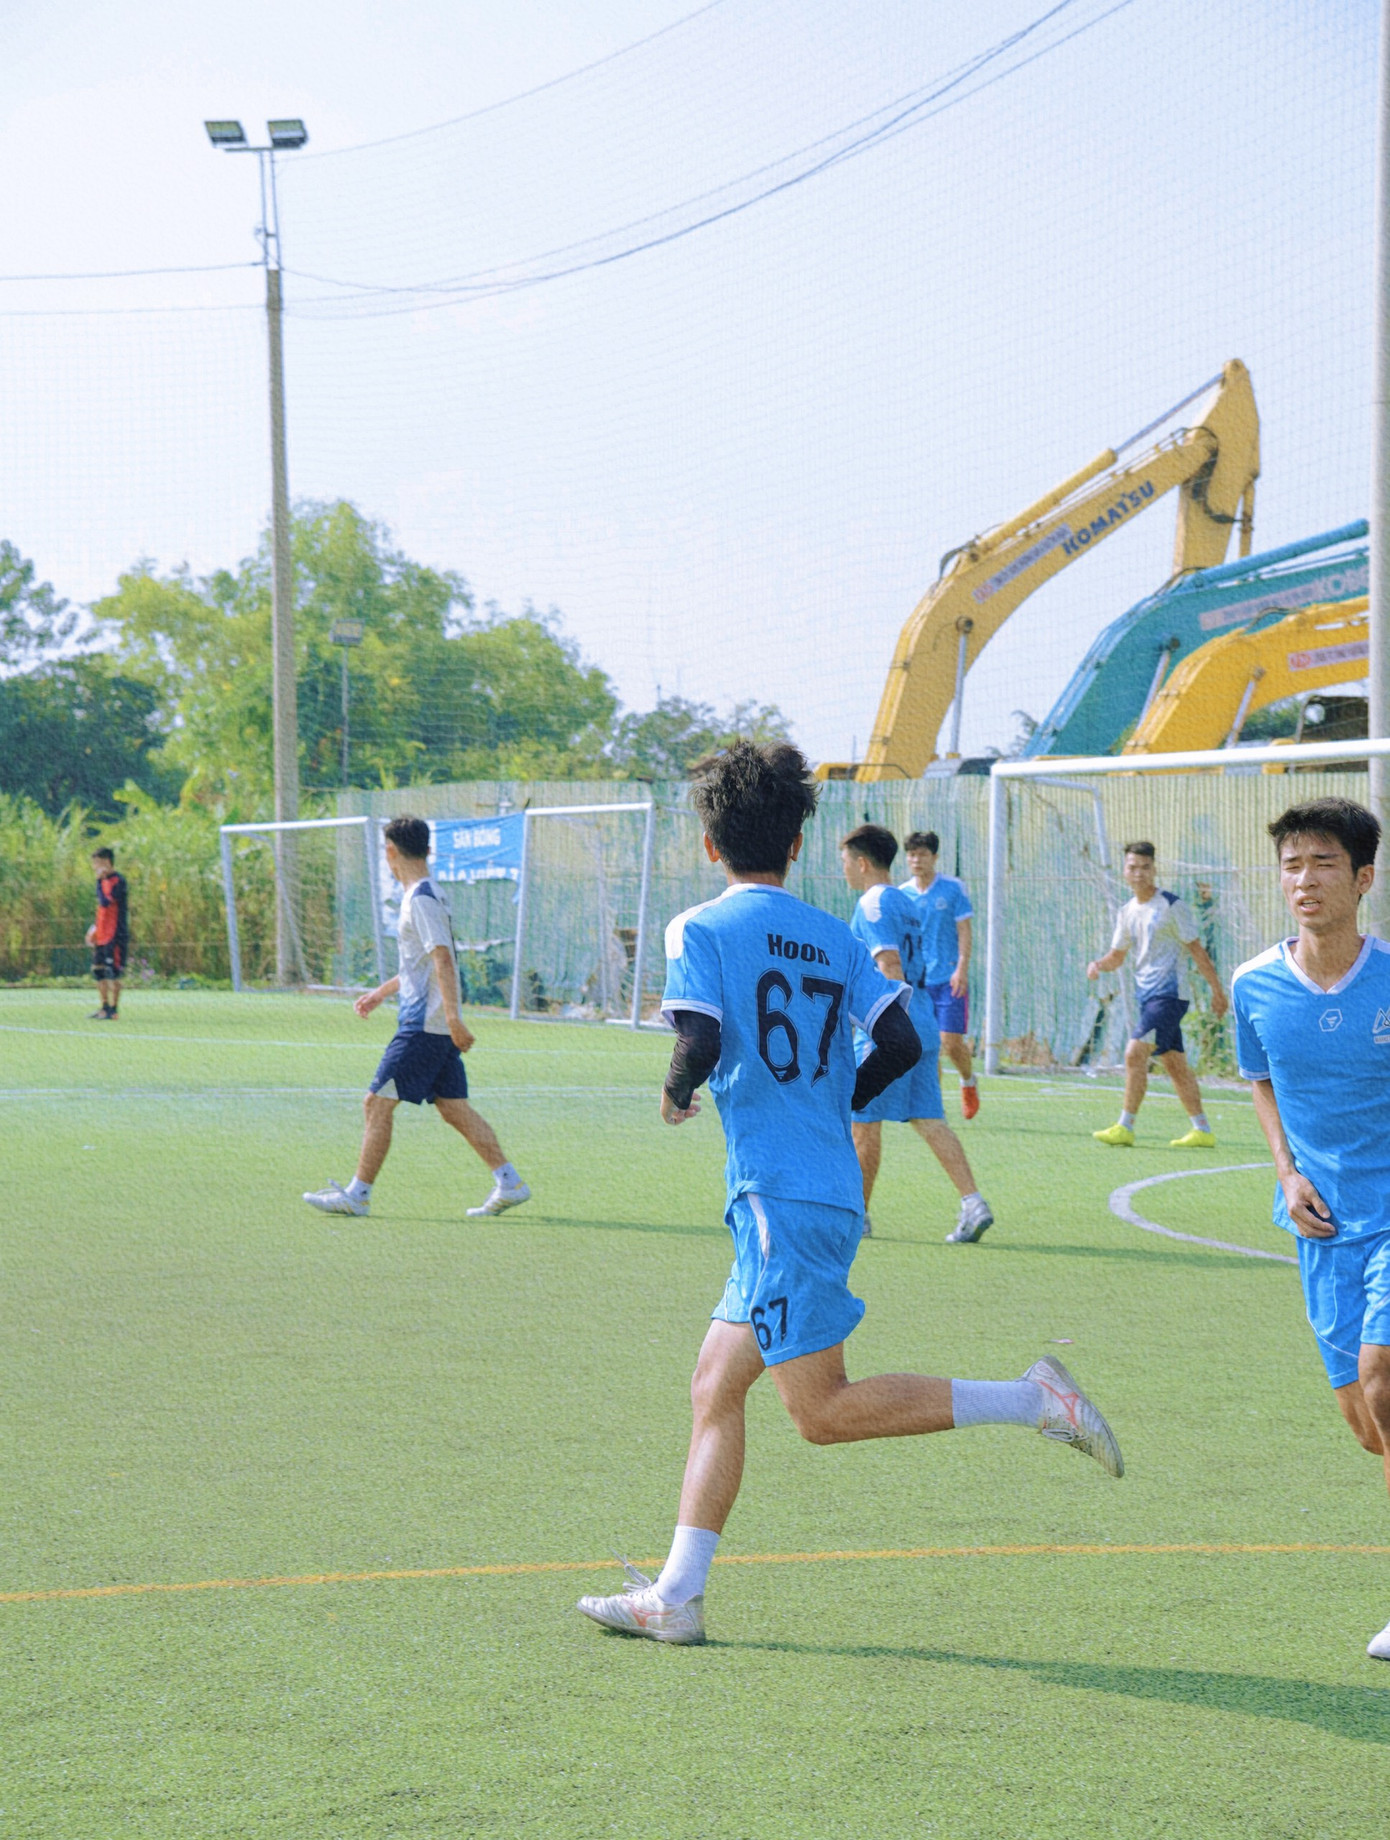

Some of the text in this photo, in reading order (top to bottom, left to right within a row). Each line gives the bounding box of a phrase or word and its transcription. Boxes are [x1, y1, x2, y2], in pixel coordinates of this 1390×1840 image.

[1062, 480, 1154, 555] KOMATSU
[756, 967, 845, 1087] 67
[751, 1296, 788, 1351] 67
